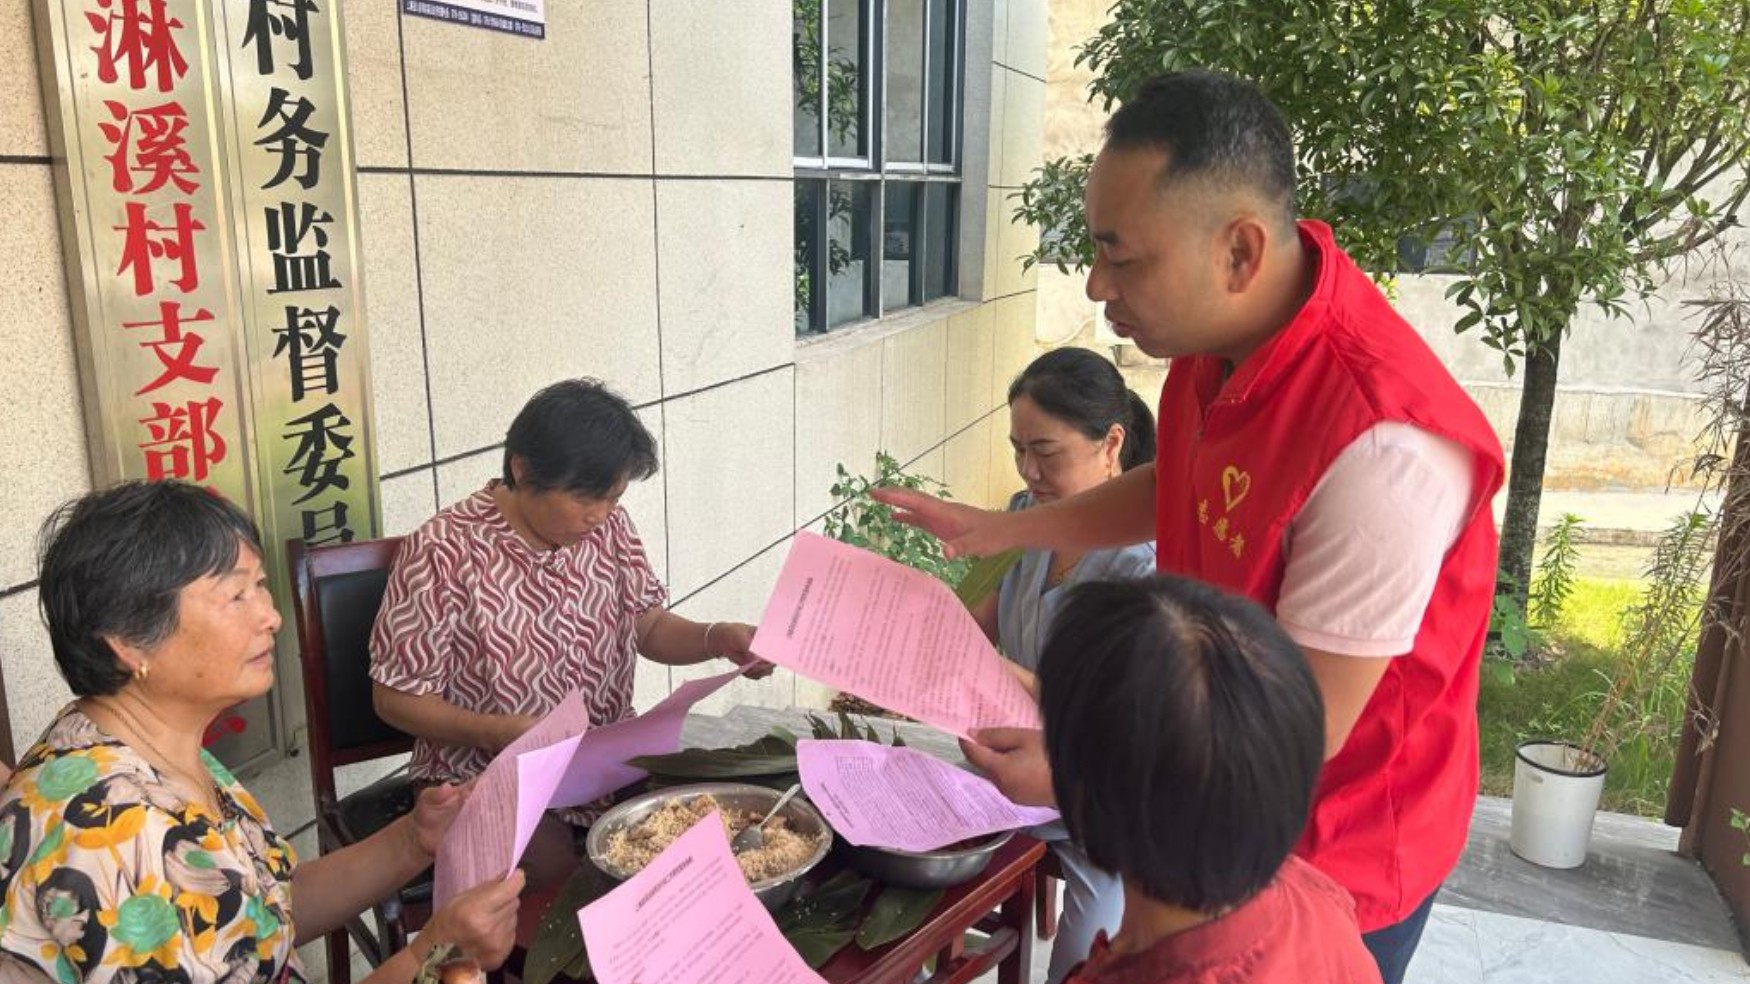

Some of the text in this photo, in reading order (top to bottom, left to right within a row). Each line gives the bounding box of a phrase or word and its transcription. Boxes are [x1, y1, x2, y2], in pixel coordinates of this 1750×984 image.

[84, 0, 227, 498] 淋溪村支部
